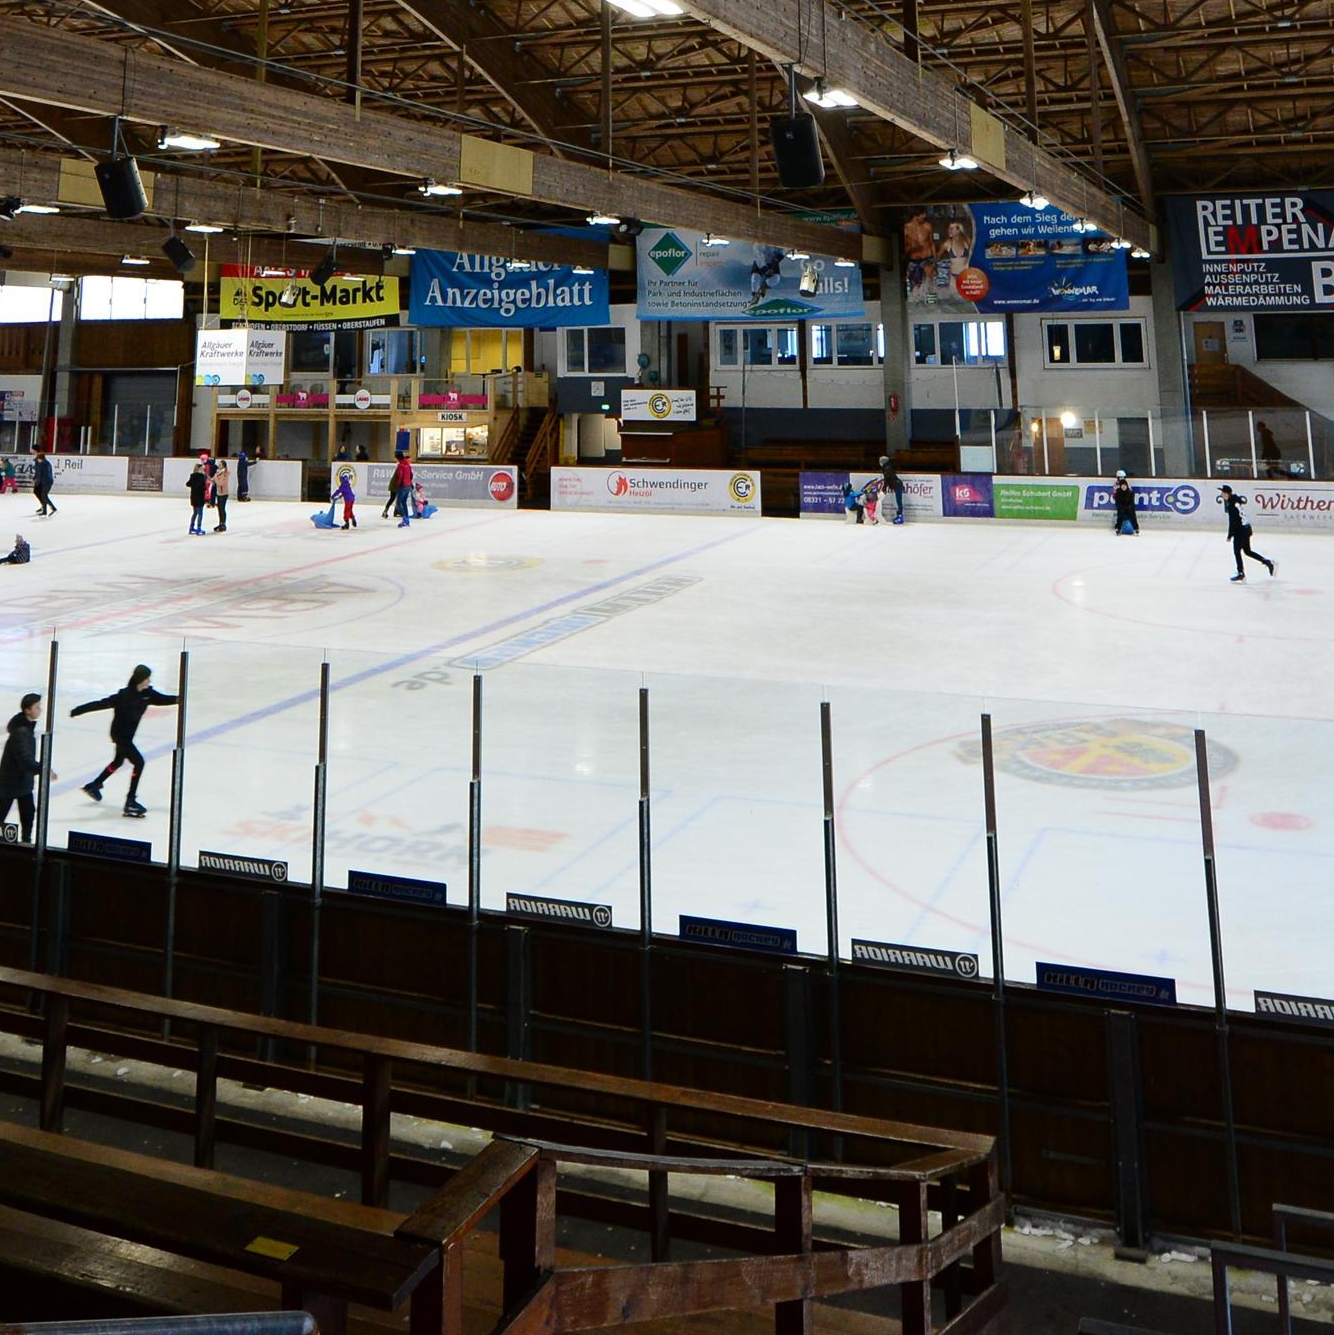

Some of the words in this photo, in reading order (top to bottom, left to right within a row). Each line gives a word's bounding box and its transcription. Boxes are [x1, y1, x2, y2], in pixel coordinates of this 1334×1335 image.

[1196, 197, 1307, 226] REITER
[984, 215, 1008, 225] Nach
[1011, 214, 1032, 224] dem
[1035, 212, 1058, 225] Sieg
[989, 226, 1018, 239] gehen
[1020, 224, 1035, 235] wir
[649, 248, 686, 260] epoflor
[1202, 263, 1266, 273] INNENPUTZ
[647, 279, 657, 288] Ihr
[659, 279, 685, 288] Partner
[1204, 273, 1280, 284] AUSSENPUTZ
[813, 276, 849, 295] ulls!
[1204, 284, 1302, 295] MALERARBEITEN
[424, 278, 594, 317] Anzeigeblatt
[647, 289, 666, 298] Park-
[667, 289, 681, 298] und
[647, 300, 669, 308] sowie
[670, 300, 749, 310] Betoninstandsetzung
[1206, 294, 1310, 306] WÄRMEDÄMMUNG
[313, 321, 338, 331] FÜSSEN
[342, 317, 386, 330] OBERSTAUFEN
[201, 340, 234, 351] Allgäuer
[199, 349, 244, 358] Kraftwerke
[248, 349, 284, 358] Kraftwerke
[441, 413, 464, 422] KIOSK
[65, 458, 84, 470] Reil
[454, 470, 484, 481] GmbH
[630, 477, 709, 492] Schwendinger
